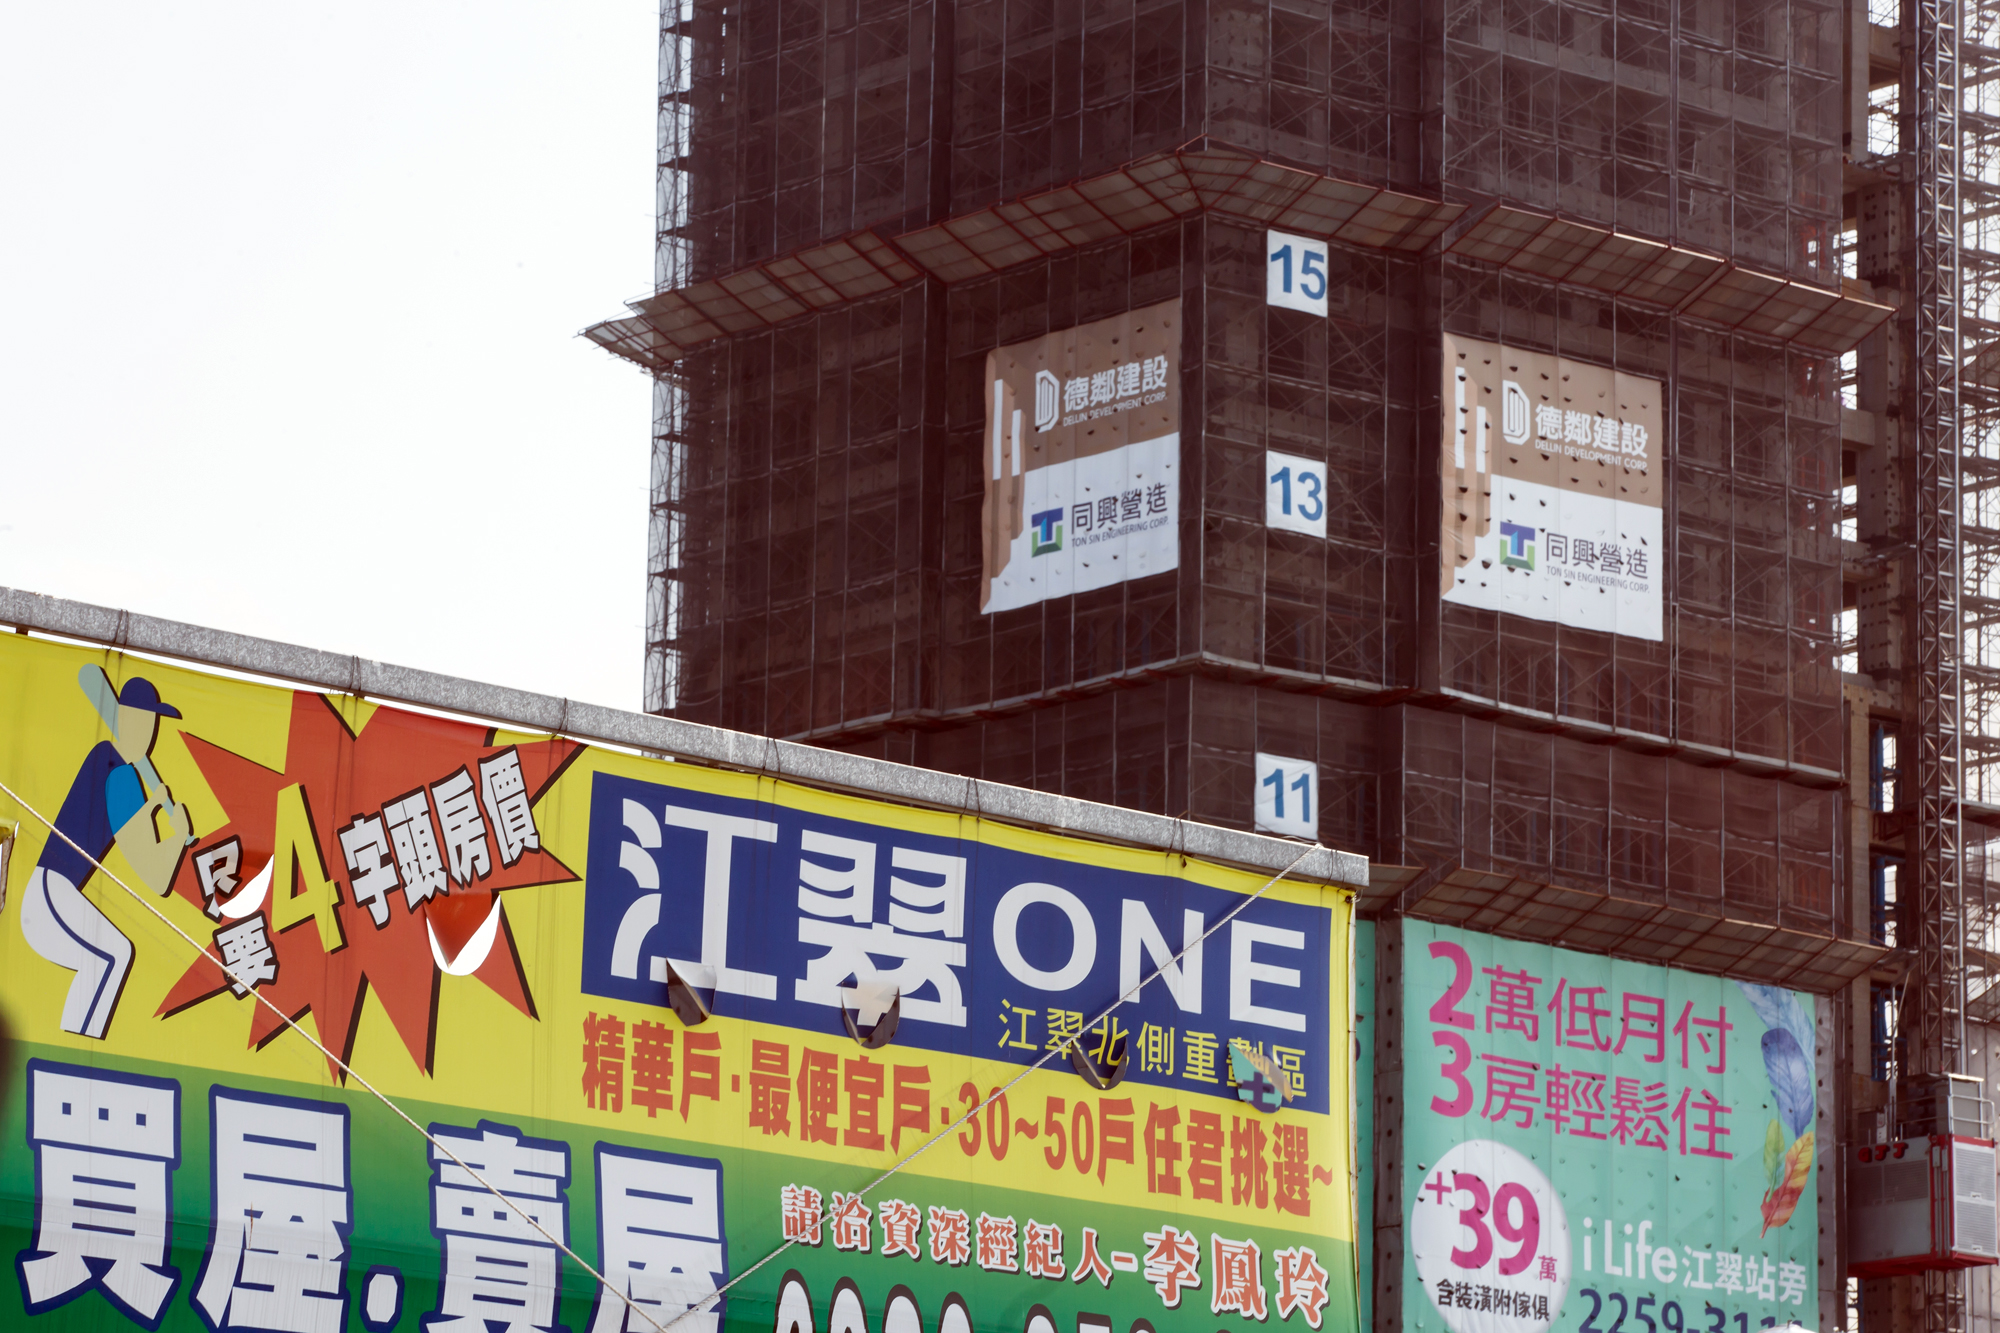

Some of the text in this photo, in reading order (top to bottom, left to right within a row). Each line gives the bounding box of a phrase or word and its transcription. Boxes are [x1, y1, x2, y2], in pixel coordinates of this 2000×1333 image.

[1269, 244, 1327, 300] 15
[1063, 355, 1168, 413] 德鄰建設
[1063, 391, 1168, 427] DELLIN DEVELOPMENT CORP.
[1535, 403, 1649, 459] 德鄰建設
[1535, 439, 1649, 473] DELLIN DEVELOPMENT CORP.
[1071, 482, 1168, 535] 同興營造
[1269, 466, 1324, 521] 13
[1071, 516, 1169, 548] TON SIN ENGINEERING CORP.
[1546, 532, 1649, 580] 同興營造
[1546, 565, 1650, 594] TON SIN ENGINEERING CORP.
[1263, 769, 1310, 823] 11
[1428, 941, 1734, 1075] 2萬低月付
[1430, 1030, 1734, 1160] 3房輕鬆住
[1436, 1278, 1550, 1322] 含裝潢附傢俱
